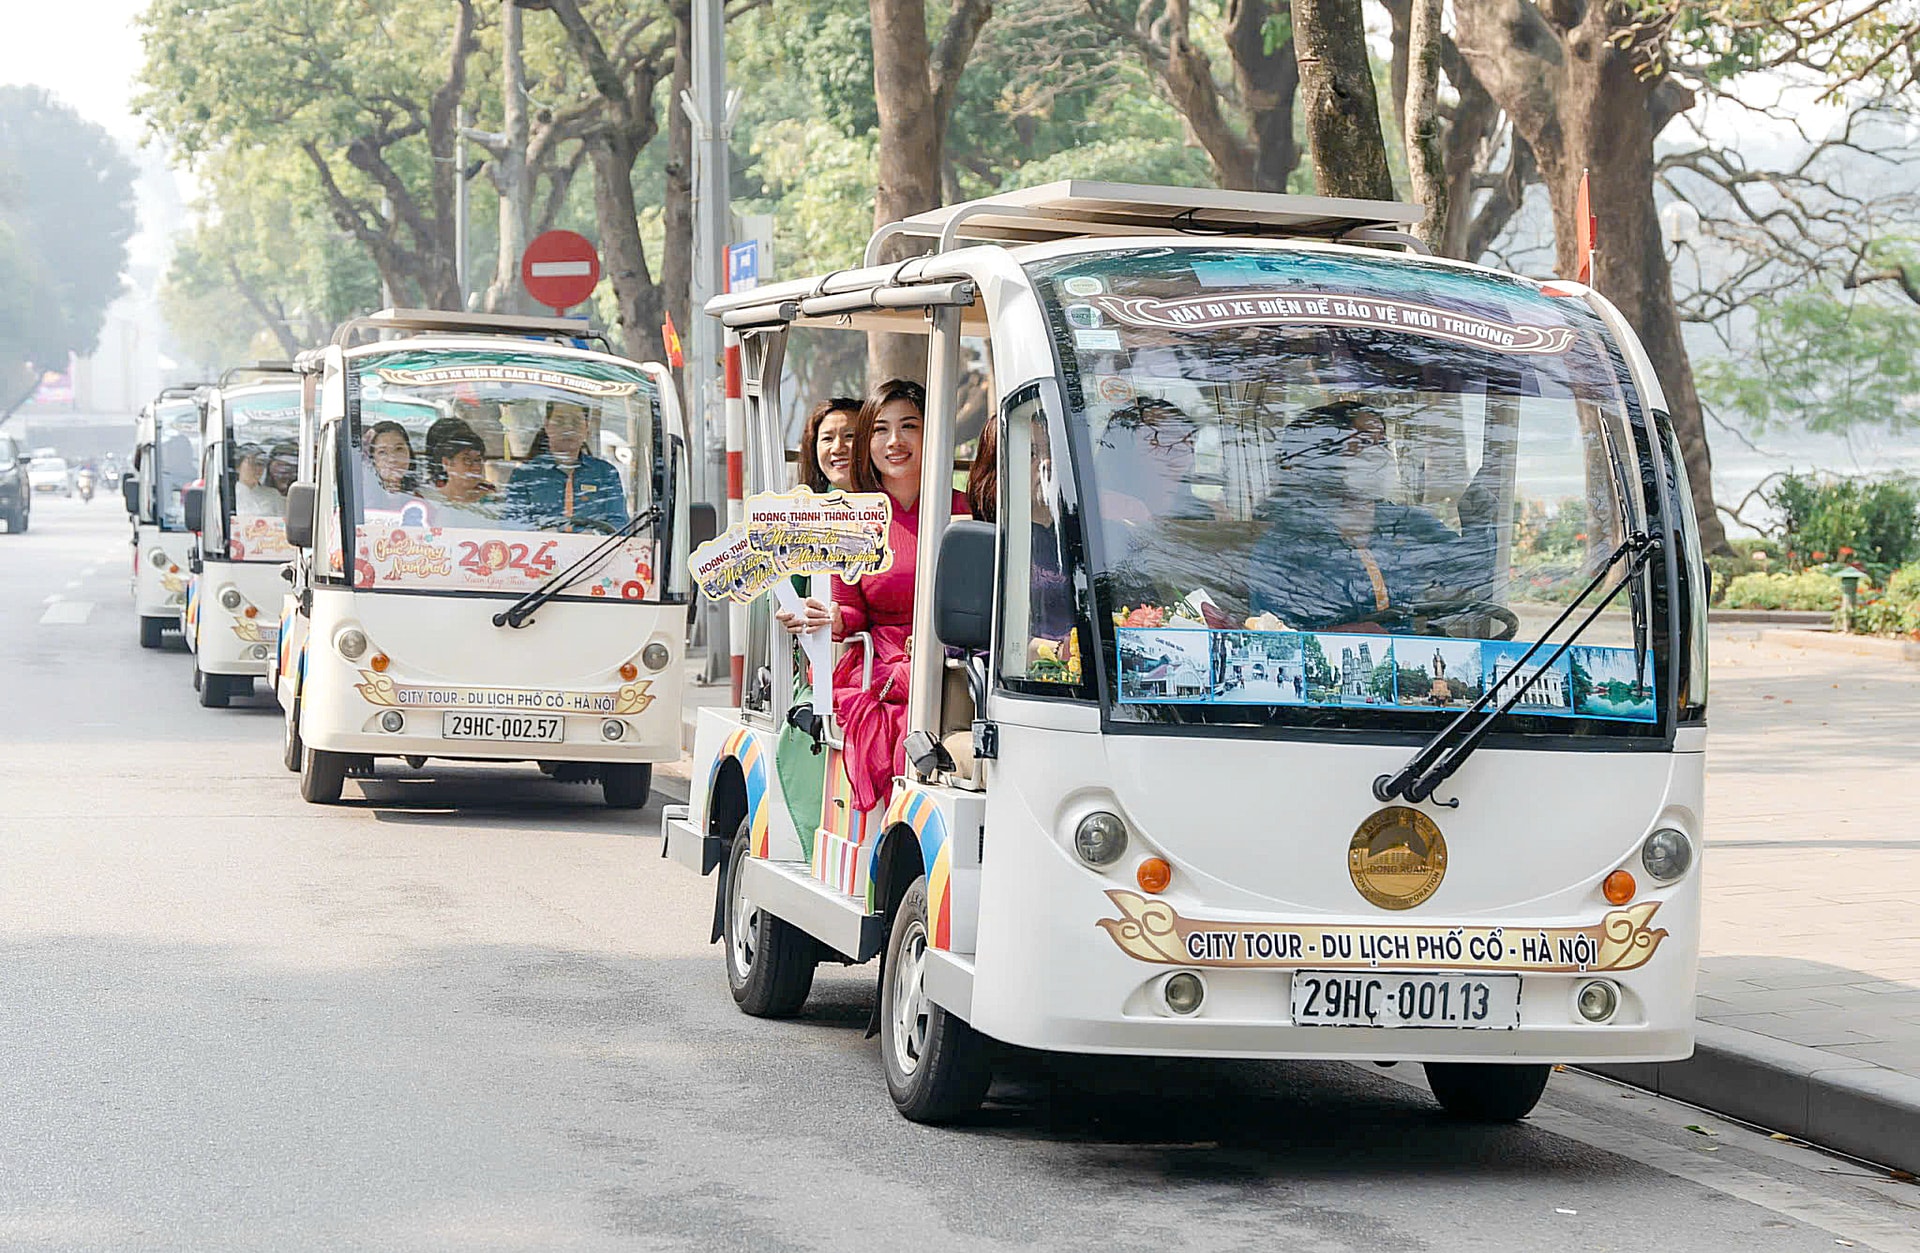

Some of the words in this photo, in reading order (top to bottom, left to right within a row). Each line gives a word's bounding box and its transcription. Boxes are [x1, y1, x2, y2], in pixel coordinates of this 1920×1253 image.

[1167, 303, 1206, 323] HÃY
[1206, 303, 1230, 317] ĐI
[1229, 301, 1257, 315] XE
[1255, 297, 1303, 317] ĐIỆN
[1303, 297, 1331, 316] ĐỂ
[1332, 300, 1371, 318] BẢO
[1374, 305, 1399, 325] VỆ
[1402, 309, 1438, 329] MÔI
[1442, 316, 1515, 347] TRƯỜNG
[858, 511, 885, 521] LONG
[458, 540, 557, 572] 2024
[398, 690, 424, 703] CITY
[427, 691, 458, 704] TOUR
[468, 692, 484, 704] DU
[574, 694, 590, 710] HÀ
[1187, 932, 1237, 959] CITY
[1243, 933, 1303, 959] TOUR
[1321, 934, 1351, 959] DU
[1359, 934, 1410, 966] LỊCH
[1416, 928, 1464, 960] PHỐ
[1469, 928, 1503, 961] CỔ
[1522, 932, 1553, 962] HÀ
[1559, 933, 1597, 971] NỘI
